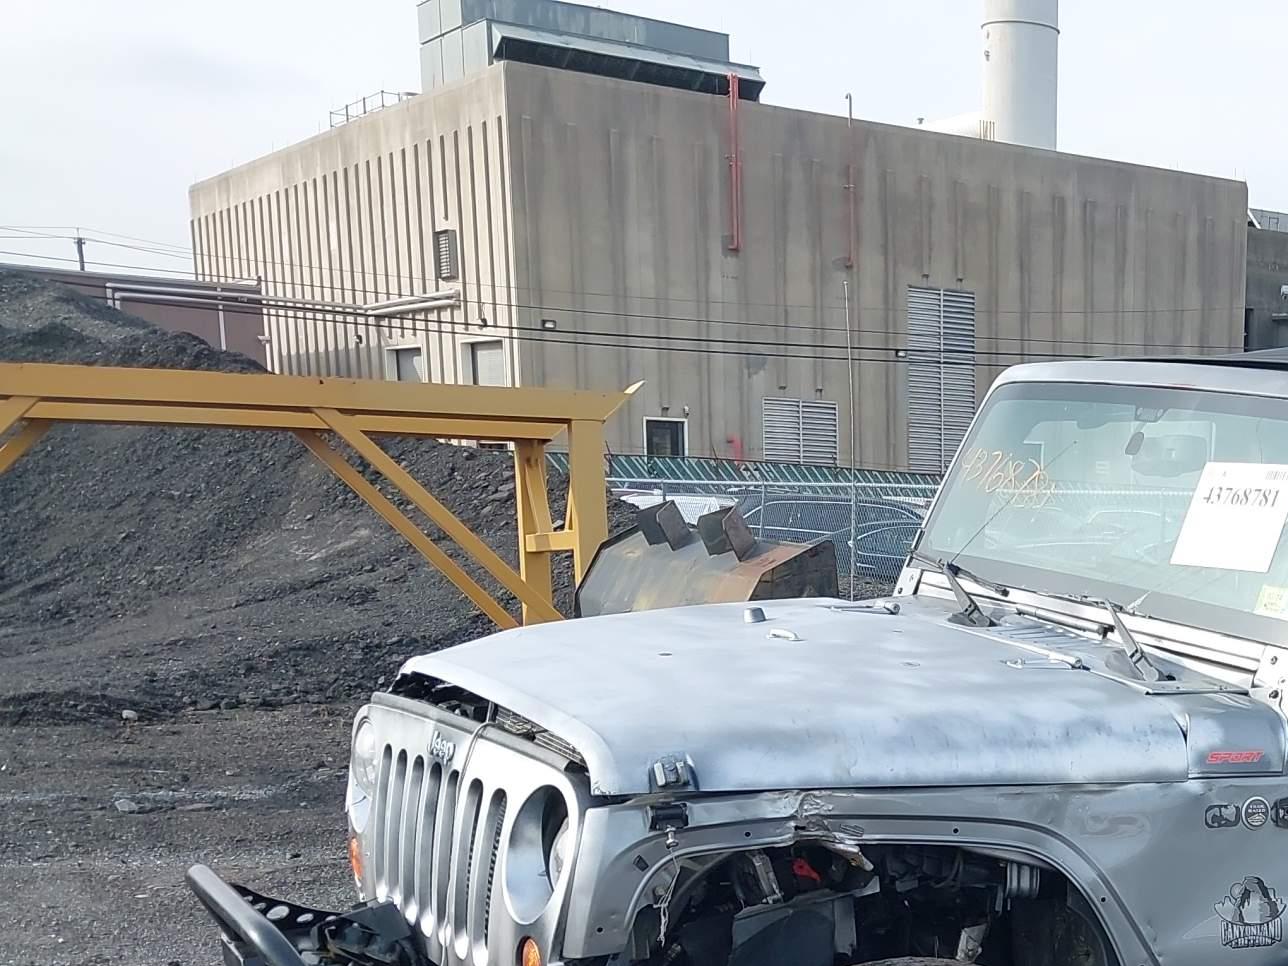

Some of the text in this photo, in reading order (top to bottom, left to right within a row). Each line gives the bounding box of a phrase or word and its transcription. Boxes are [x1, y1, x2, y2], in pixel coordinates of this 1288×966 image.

[1203, 486, 1280, 508] 43768781
[427, 730, 456, 766] Jeep
[1206, 750, 1265, 764] SPORT
[1220, 916, 1283, 946] CANYONLAND
[1231, 936, 1273, 949] EDITION
